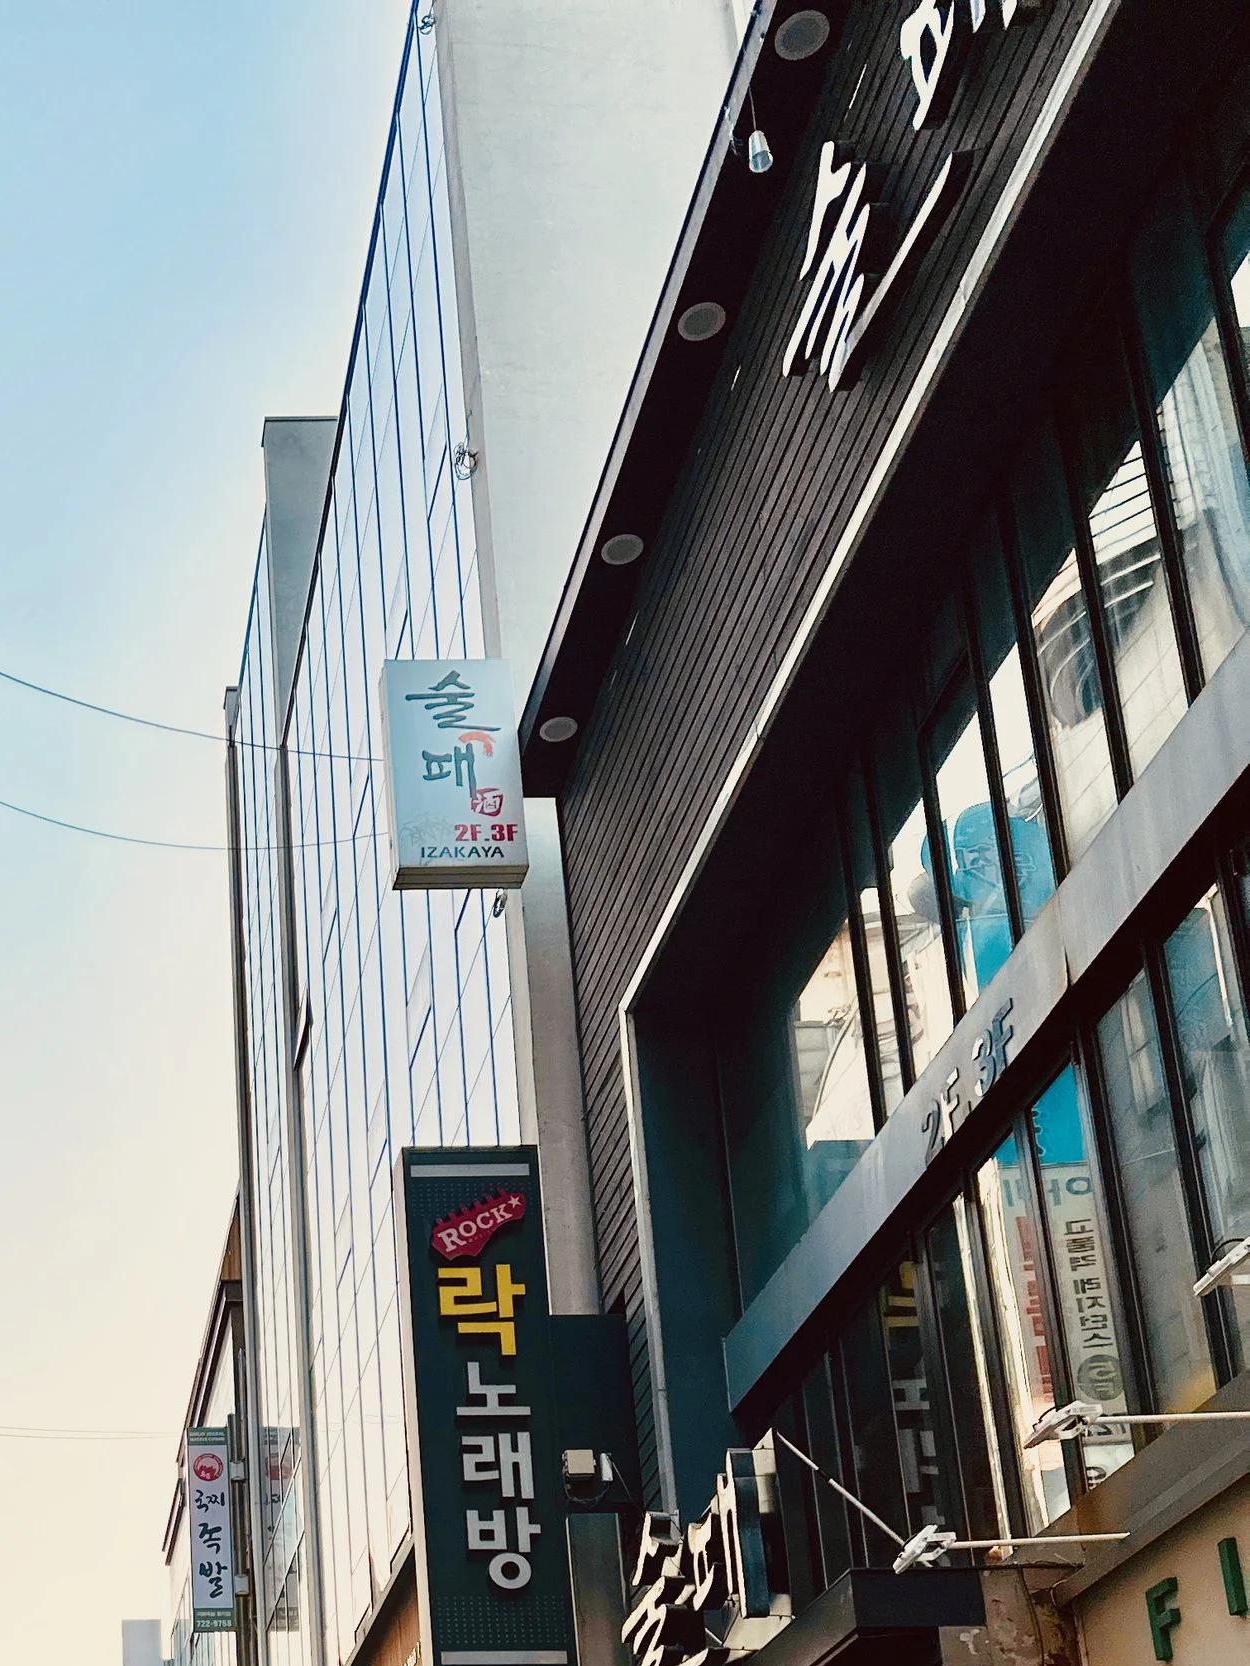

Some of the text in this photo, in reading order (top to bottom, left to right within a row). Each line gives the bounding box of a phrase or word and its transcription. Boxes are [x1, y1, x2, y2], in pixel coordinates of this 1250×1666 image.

[404, 669, 502, 802] 술패
[420, 845, 505, 859] IZAKAYA
[437, 1203, 513, 1253] ROCK
[455, 1361, 542, 1590] 노래방
